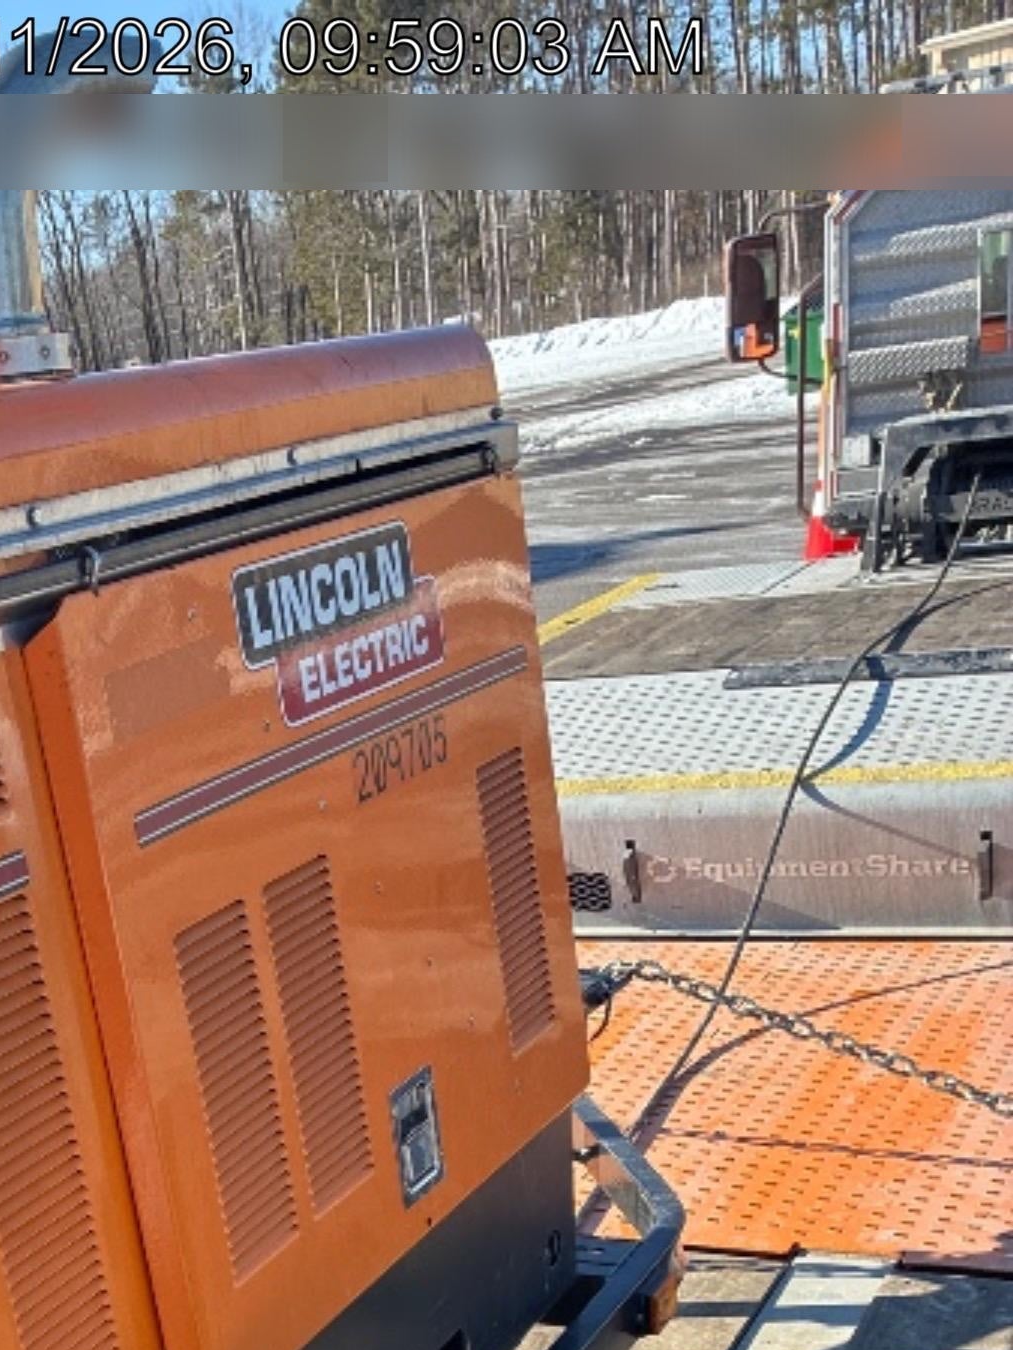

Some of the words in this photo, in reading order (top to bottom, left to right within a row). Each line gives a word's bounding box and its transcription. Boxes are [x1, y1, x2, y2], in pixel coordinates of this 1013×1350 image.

[244, 539, 406, 650] LINCOLN
[298, 613, 430, 704] ELECTRIC
[352, 714, 448, 803] 209705
